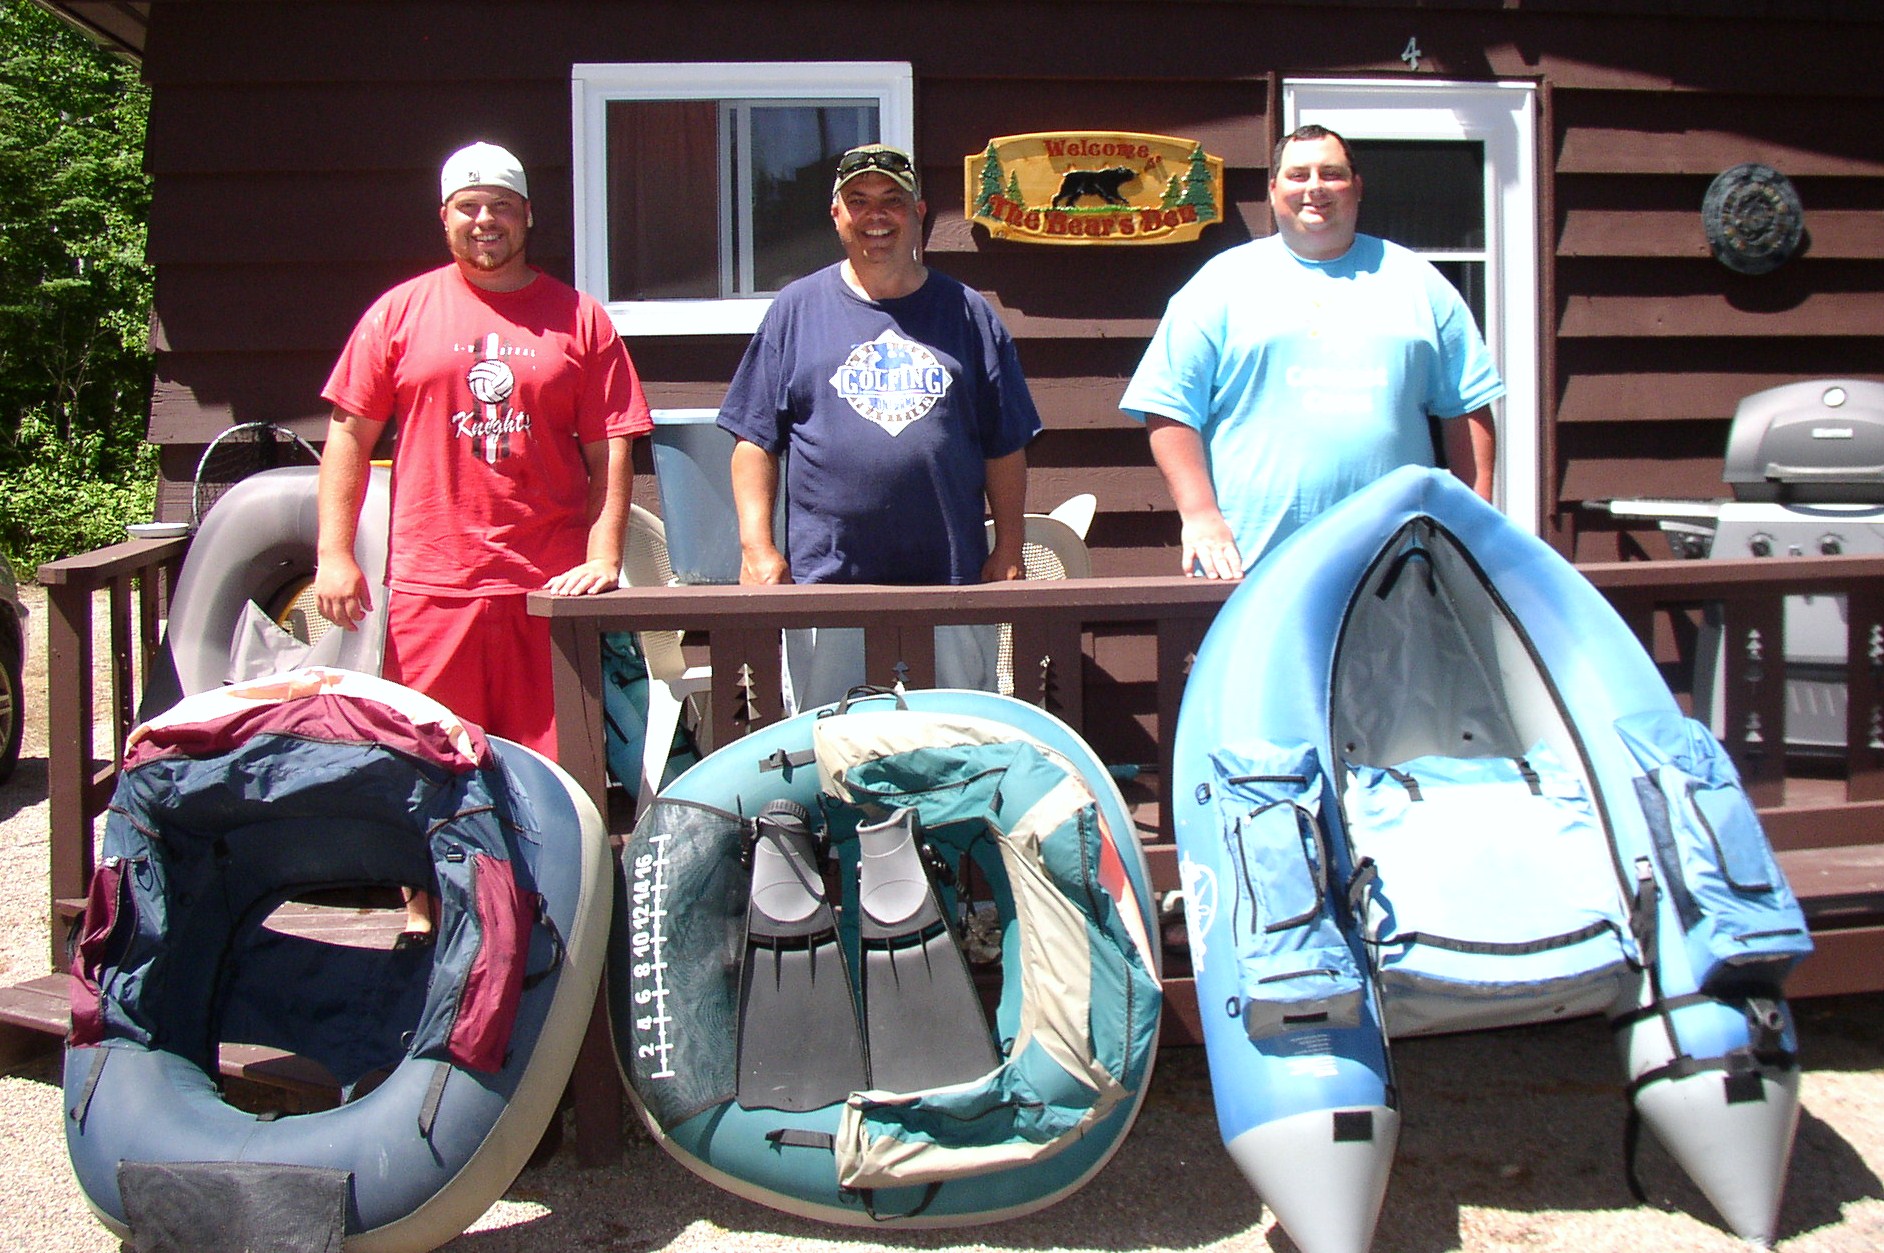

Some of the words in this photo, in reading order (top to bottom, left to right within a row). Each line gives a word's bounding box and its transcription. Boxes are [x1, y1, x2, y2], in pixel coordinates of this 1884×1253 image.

[1401, 37, 1421, 70] 4
[1043, 139, 1149, 159] Welcome
[989, 194, 1040, 230] The
[1045, 210, 1135, 236] Bear's
[1140, 204, 1197, 231] Den
[842, 367, 942, 394] GOLFING
[635, 854, 652, 879] 16
[633, 879, 651, 905] 14
[632, 903, 650, 930] 12
[632, 931, 650, 958] 10
[633, 962, 650, 978] 8
[635, 989, 651, 1004] 6
[637, 1015, 652, 1030] 4
[638, 1043, 655, 1058] 2
